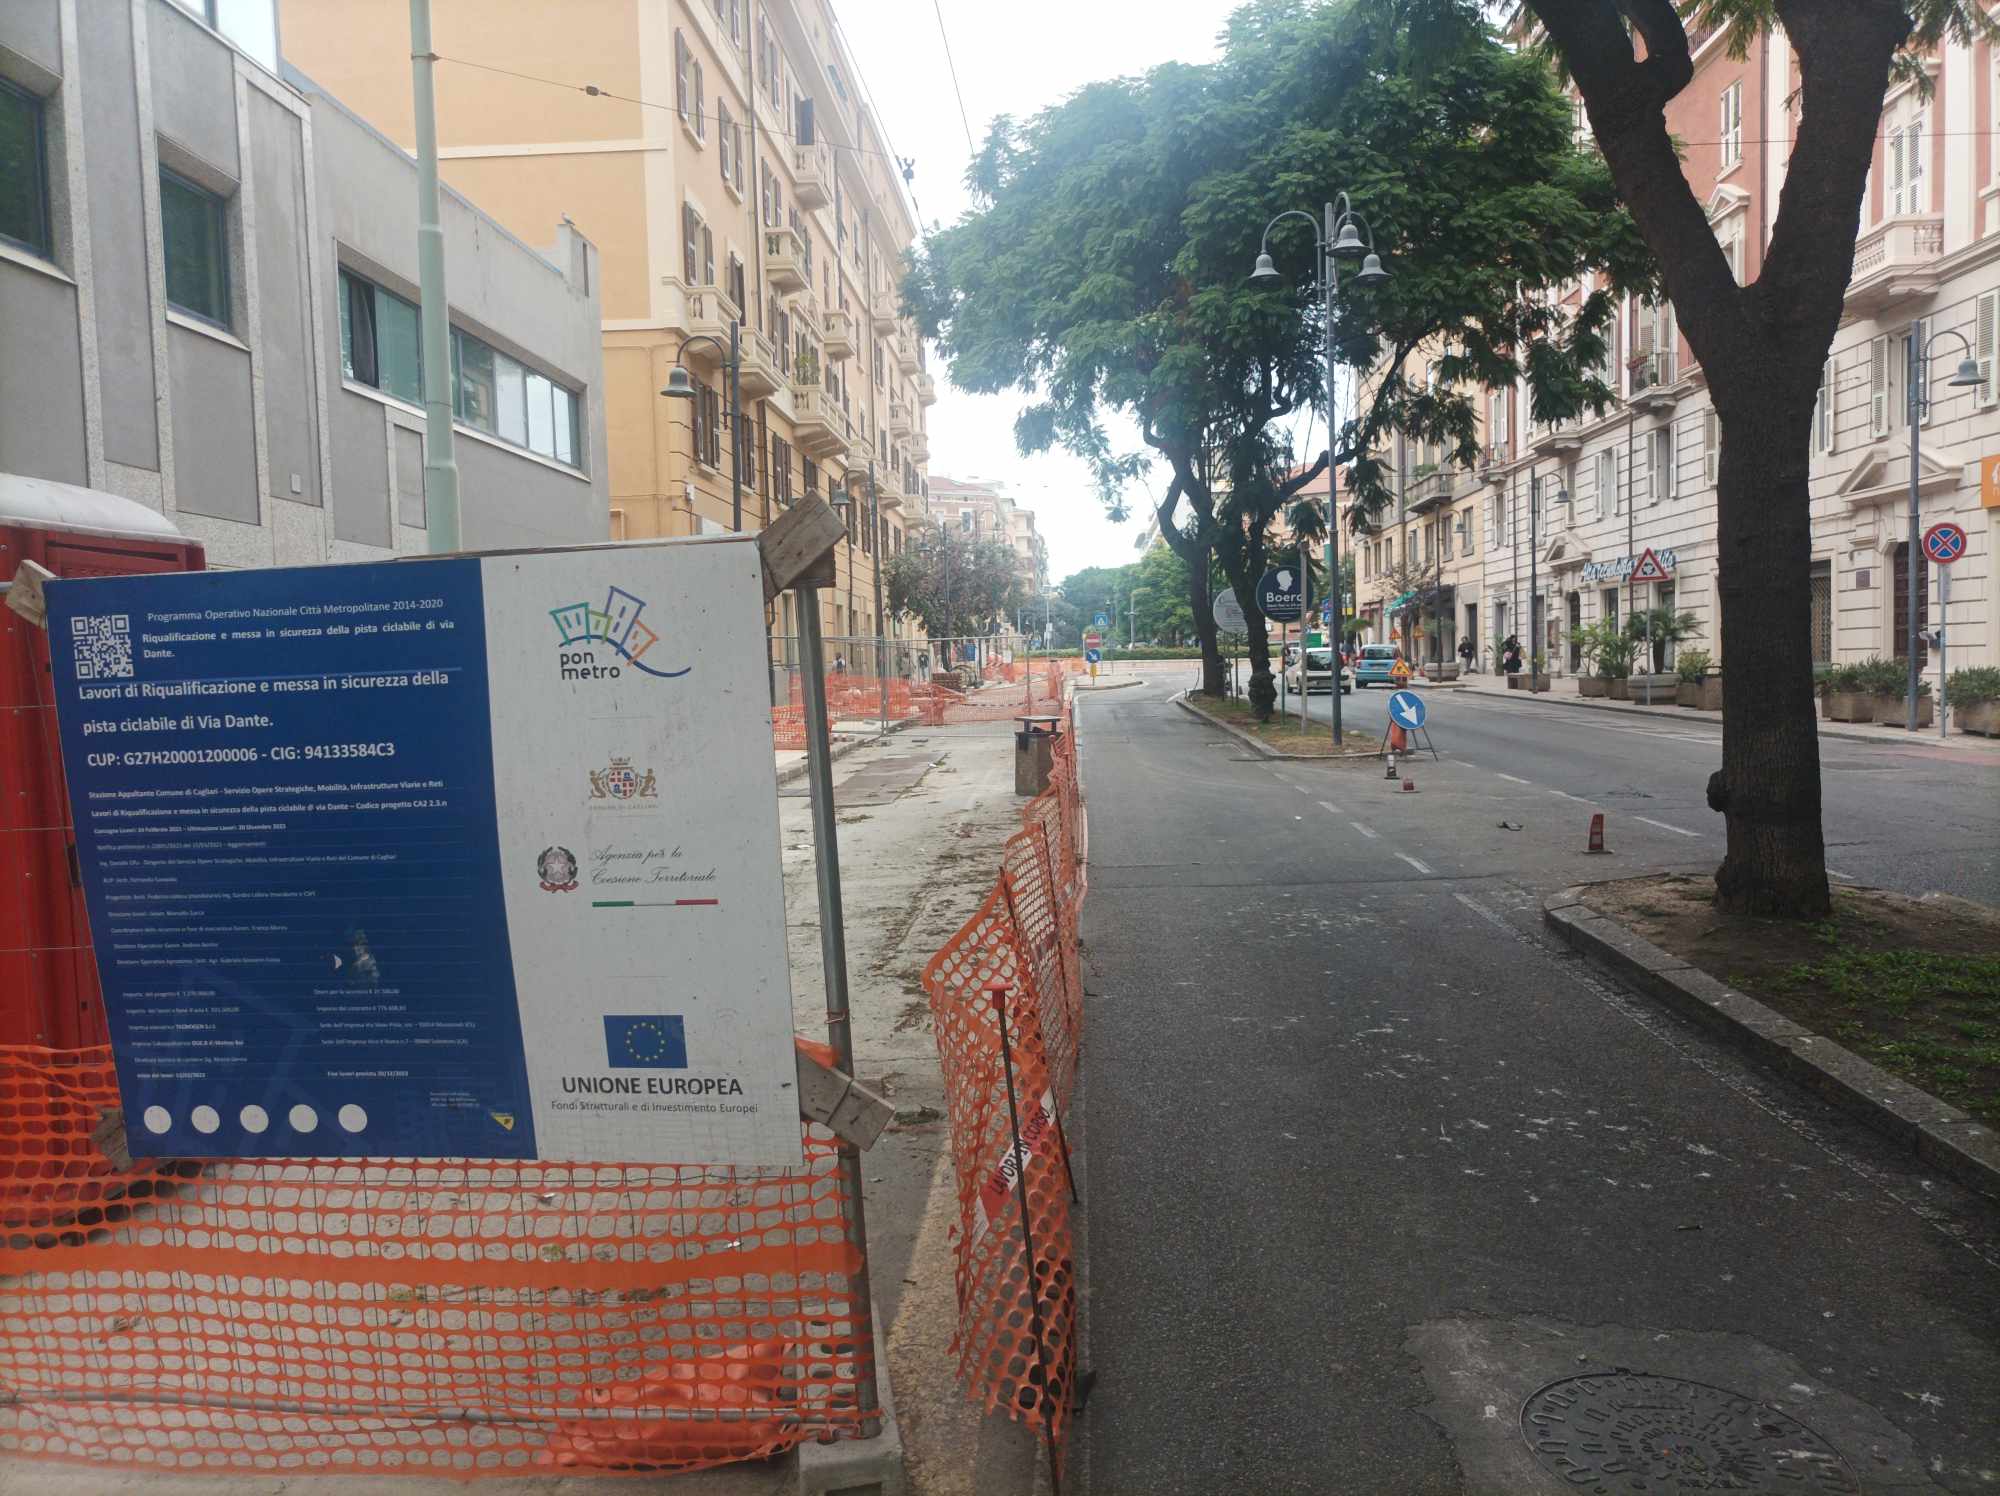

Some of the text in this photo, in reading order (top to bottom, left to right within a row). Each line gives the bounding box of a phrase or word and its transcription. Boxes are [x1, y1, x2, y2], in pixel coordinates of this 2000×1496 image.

[147, 599, 443, 623] Programma Operativo Nazionale Città Metropolitane 2014-2020
[142, 632, 216, 644] Riqualificazione
[232, 631, 261, 639] messa
[266, 628, 275, 637] in
[280, 627, 321, 638] sicurezza
[327, 625, 349, 635] della
[354, 624, 378, 635] pista
[382, 621, 421, 632] ciclabile
[426, 620, 435, 630] di
[440, 620, 454, 629] via
[144, 649, 175, 658] Dante.
[560, 652, 594, 668] pon
[561, 665, 620, 680] metro
[79, 671, 449, 700] Lavori di Riqualificazione e messa in sicurezza della
[83, 714, 274, 736] pista ciclabile di Via Dante.
[87, 753, 121, 767] CUP:
[124, 747, 257, 766] G27H20001200006
[271, 747, 301, 760] CIG:
[305, 742, 395, 759] 94133584C3
[590, 844, 642, 866] Agenzia
[671, 845, 682, 857] la
[562, 1076, 743, 1095] UNIONE EUROPEA
[551, 1101, 758, 1114] Fondi Strutturali e di Investimento Europei
